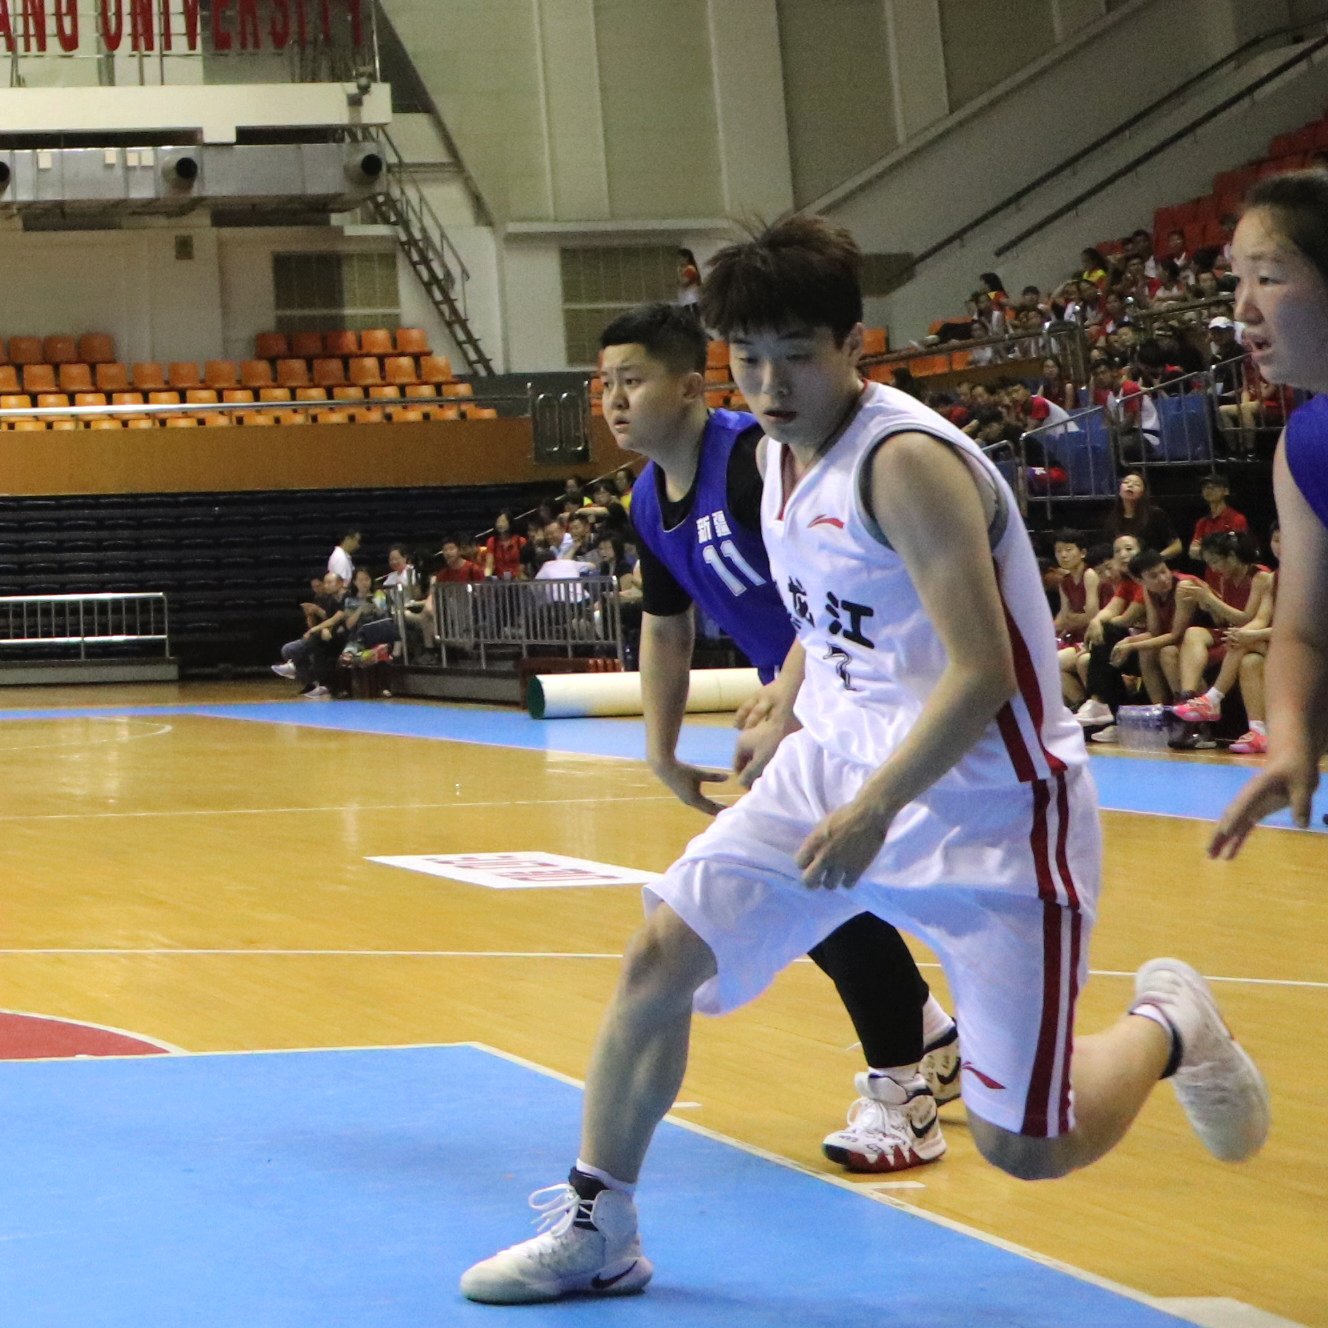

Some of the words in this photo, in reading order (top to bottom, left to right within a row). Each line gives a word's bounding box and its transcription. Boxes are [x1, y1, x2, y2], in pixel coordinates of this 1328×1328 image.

[695, 509, 732, 544] 新疆
[702, 539, 767, 597] 11
[823, 640, 858, 691] 7
